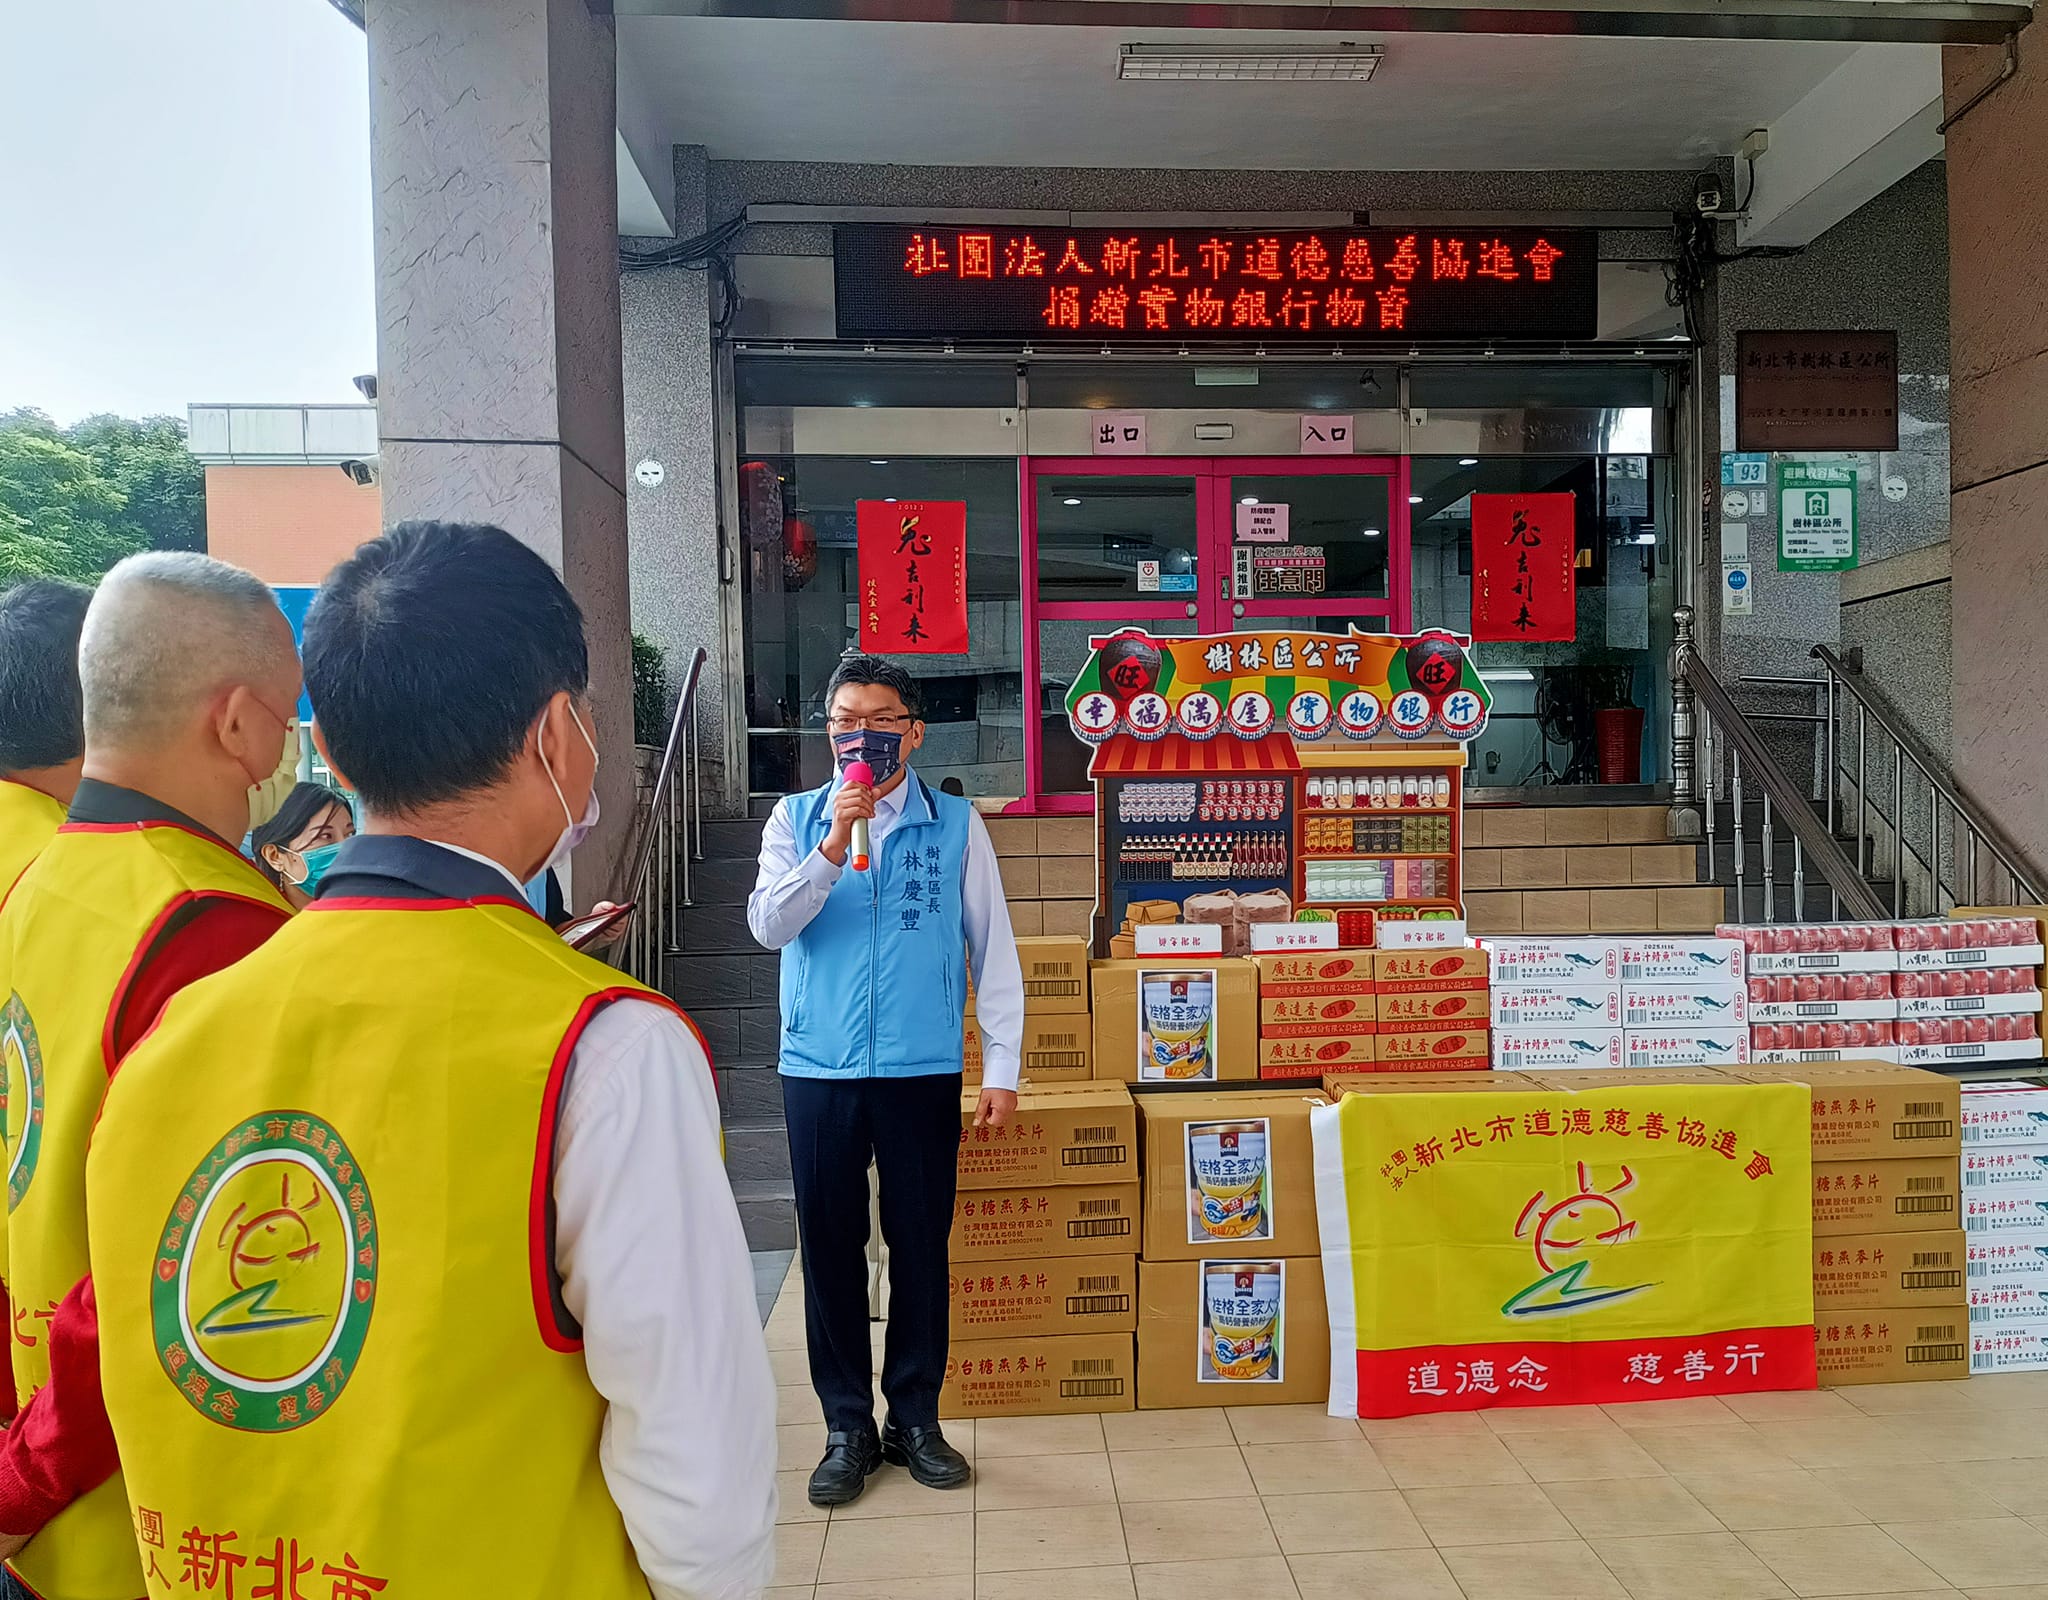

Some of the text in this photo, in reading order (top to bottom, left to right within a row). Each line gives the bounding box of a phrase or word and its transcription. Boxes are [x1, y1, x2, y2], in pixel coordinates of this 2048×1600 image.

[905, 235, 1563, 280] 社團法人新北市道德慈善協進會
[1044, 285, 1410, 329] 捐贈實物銀行物資
[1100, 424, 1139, 443] 出口
[1305, 426, 1346, 442] 入口
[1741, 464, 1760, 480] 93
[1793, 518, 1842, 528] 樹林區公所
[1236, 550, 1248, 595] 謝絕推銷
[1254, 568, 1325, 594] 任意門
[1203, 639, 1362, 674] 樹林區公所
[1115, 663, 1140, 688] 旺
[1421, 661, 1446, 685] 旺
[1085, 698, 1261, 726] 幸福滿屋
[926, 846, 943, 914] 樹林區長
[900, 850, 924, 931] 林慶豐
[1272, 961, 1316, 976] 廣達香
[1385, 959, 1428, 974] 廣達香
[1150, 1003, 1208, 1020] 桂格全家人
[1273, 1001, 1318, 1016] 廣達香
[1387, 999, 1431, 1014] 廣達香
[1270, 1043, 1313, 1058] 廣達香
[1385, 1038, 1429, 1053] 廣達香
[1812, 1098, 1876, 1116] 糖燕麥片
[1812, 1120, 1880, 1131] 糖業股份有限公司
[1413, 1108, 1776, 1181] 新北市道德慈善協進會
[1199, 1156, 1261, 1176] 桂格全家人
[1380, 1150, 1408, 1178] 社團
[1391, 1165, 1419, 1192] 法人
[1816, 1174, 1879, 1192] 糖燕麥片
[964, 1196, 1049, 1217] 台糖燕麥片
[1812, 1195, 1882, 1206] 糖業股份有限公司
[963, 1219, 1053, 1232] 台灣糖業股份有限公司
[1819, 1249, 1885, 1266] 糖燕麥片
[962, 1273, 1048, 1294] 台糖燕麥片
[1813, 1271, 1888, 1281] 灣糖業股份有限公司
[962, 1296, 1052, 1309] 台灣糖業股份有限公司
[1212, 1297, 1275, 1316] 桂格全家人
[1818, 1345, 1893, 1356] 灣糖業股份有限公司
[961, 1356, 1047, 1376] 台糖燕麥片
[1408, 1343, 1766, 1395] 道德念 慈善行
[164, 1342, 240, 1421] 道德念
[961, 1379, 1051, 1392] 台灣糖業股份有限公司
[132, 1505, 164, 1549] 團
[141, 1550, 171, 1590] 人
[178, 1526, 388, 1600] 新北市
